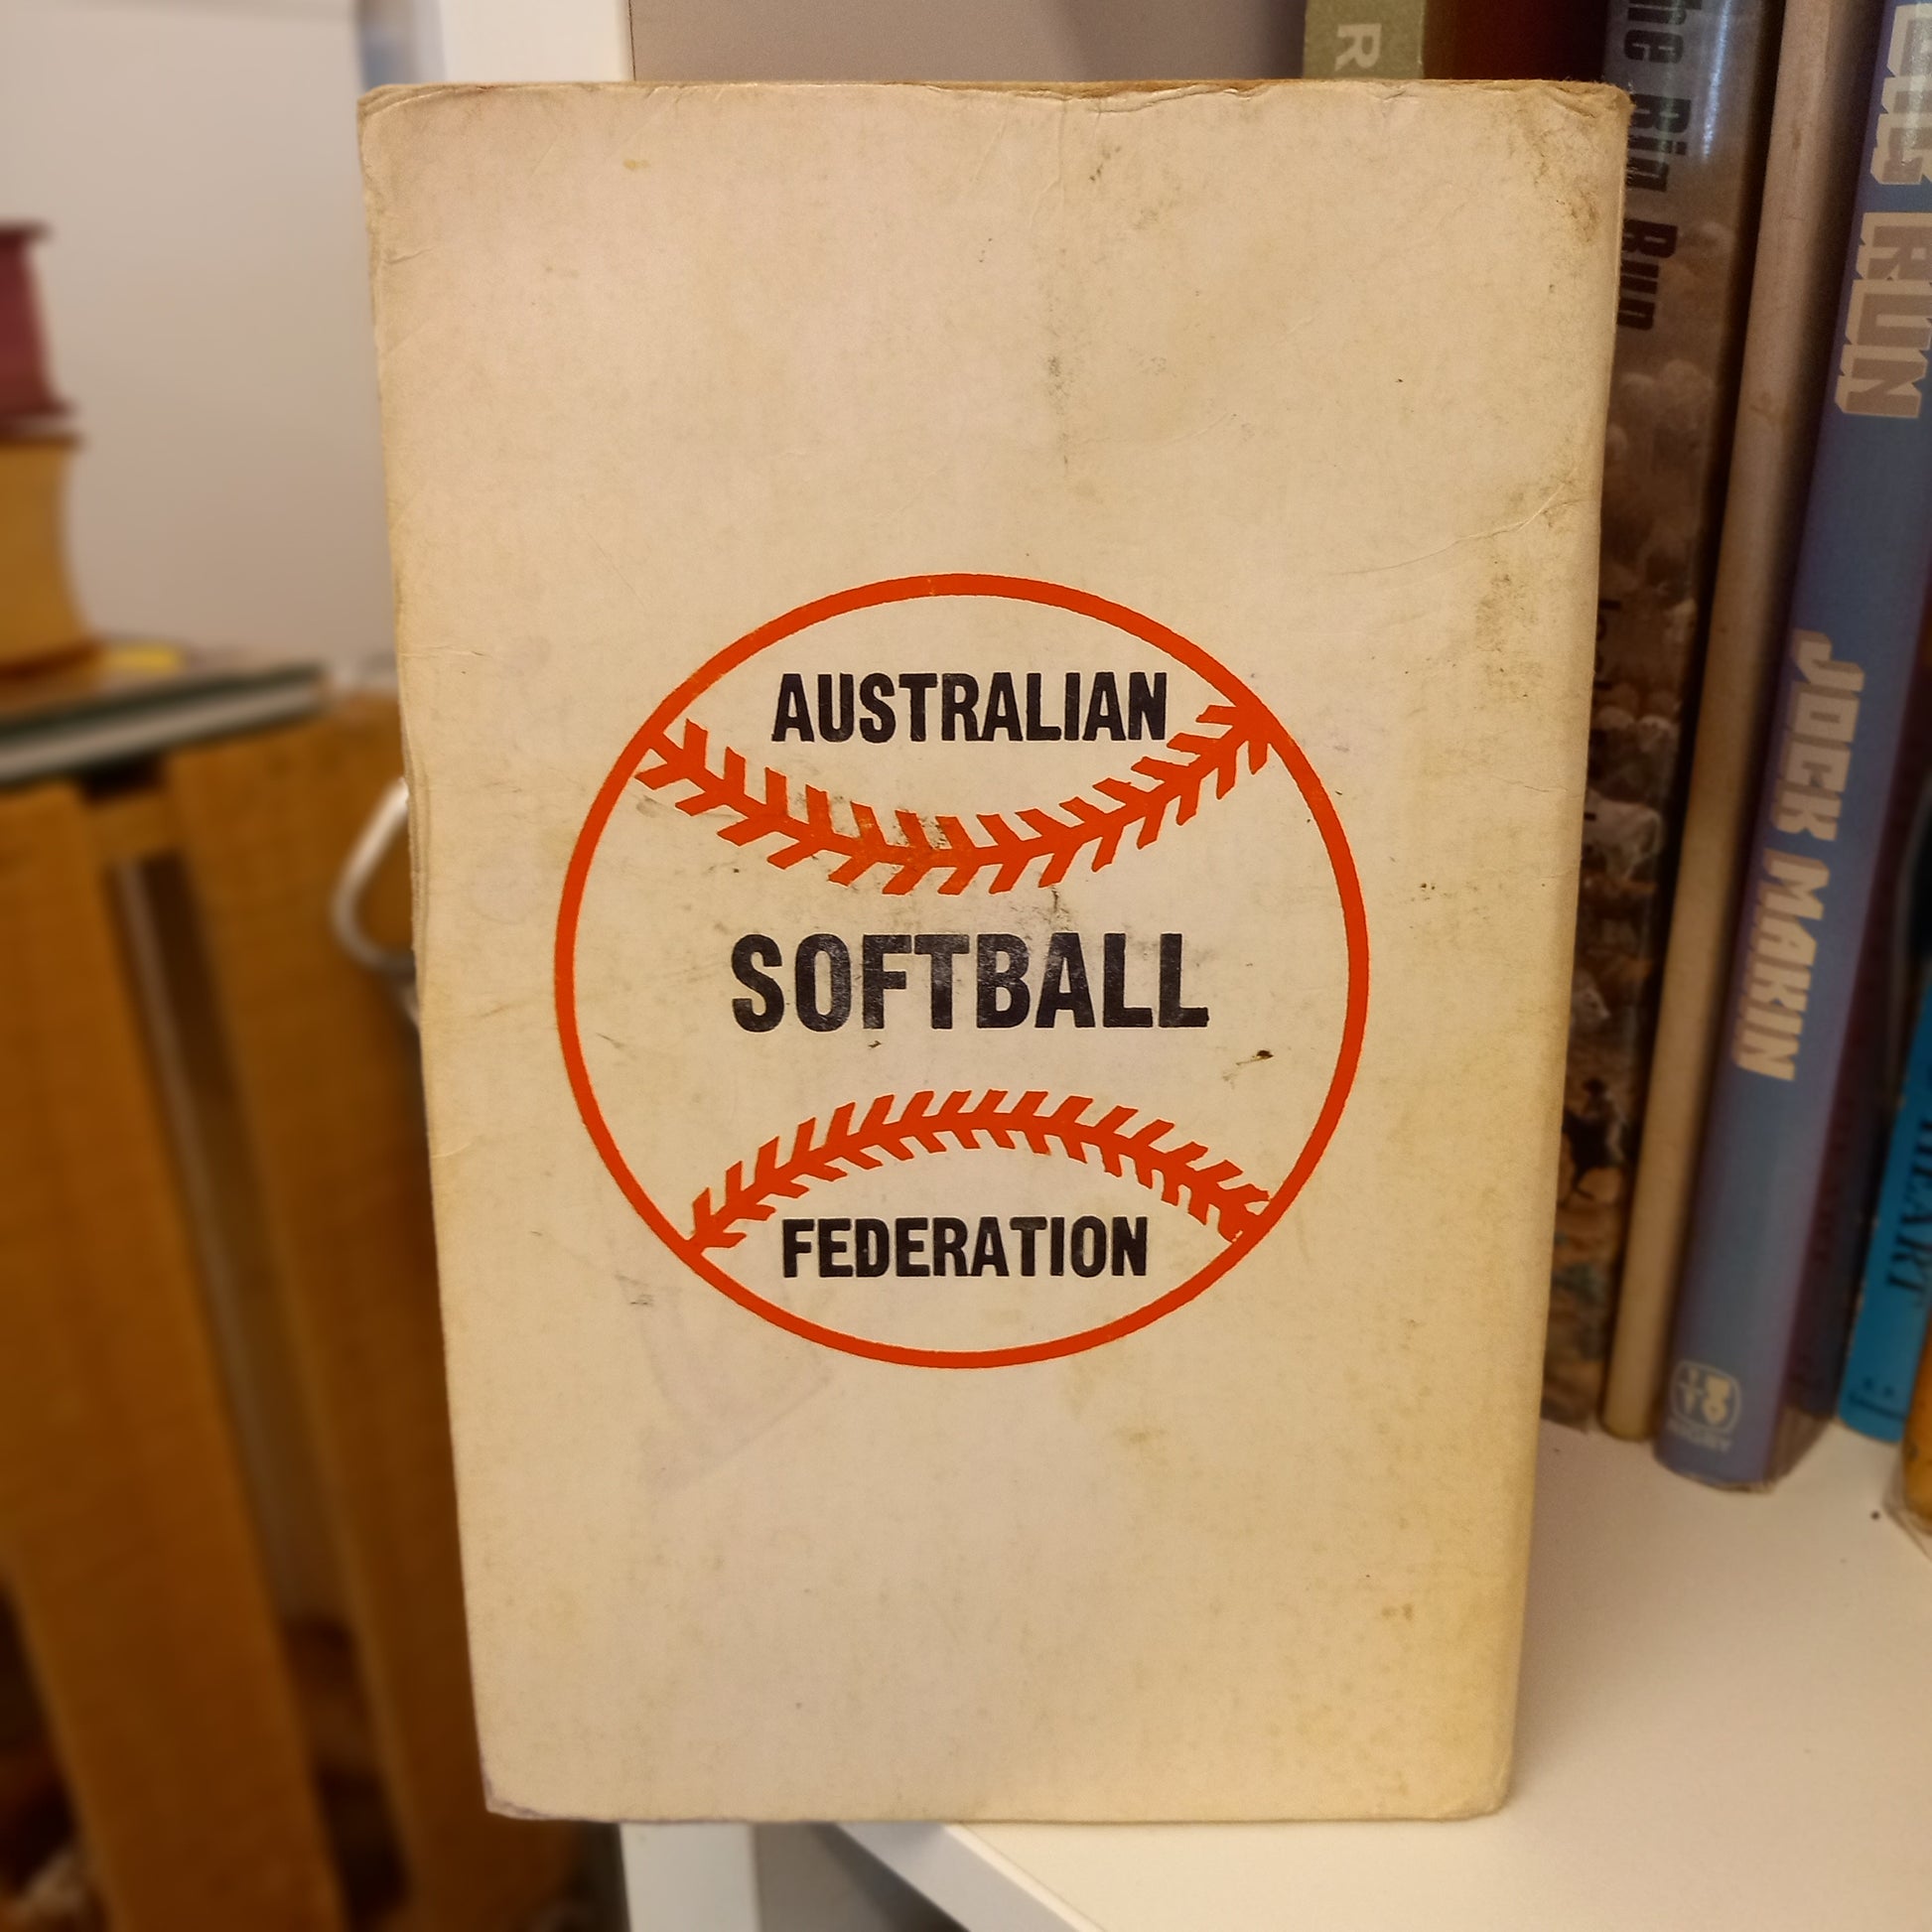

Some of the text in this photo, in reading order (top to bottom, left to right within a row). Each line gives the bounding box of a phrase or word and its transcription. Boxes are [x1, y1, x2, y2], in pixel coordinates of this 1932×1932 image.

[1836, 211, 1932, 418] RUN
[771, 671, 1169, 744] AUSTRALIAN
[1730, 627, 1865, 1082] JOCK MAKIN
[731, 932, 1209, 1033] SOFTBALL
[781, 1215, 1149, 1278] FEDERATION
